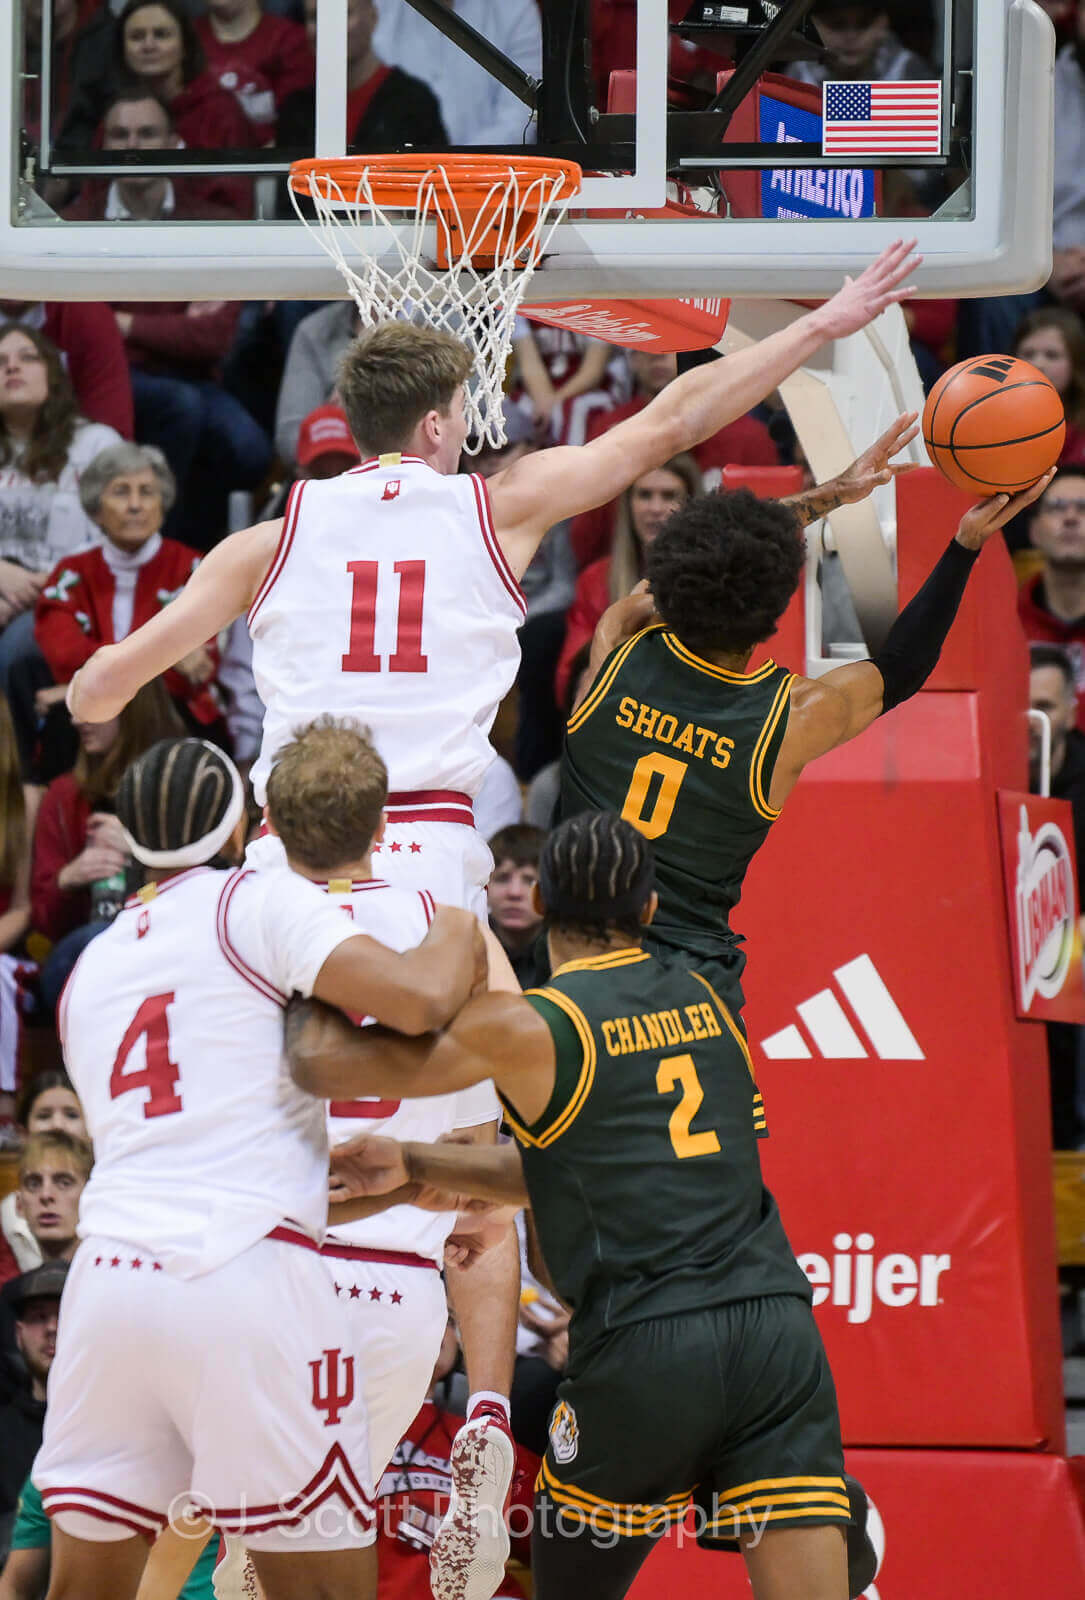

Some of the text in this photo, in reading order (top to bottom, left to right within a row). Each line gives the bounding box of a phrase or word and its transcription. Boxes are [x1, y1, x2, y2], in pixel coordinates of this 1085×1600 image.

[342, 560, 427, 672] 11
[616, 696, 735, 769] SHOATS
[620, 751, 688, 840] 0
[110, 991, 183, 1119] 4
[601, 1002, 722, 1057] CHANDLER
[655, 1053, 722, 1160] 2
[796, 1232, 951, 1324] eijer
